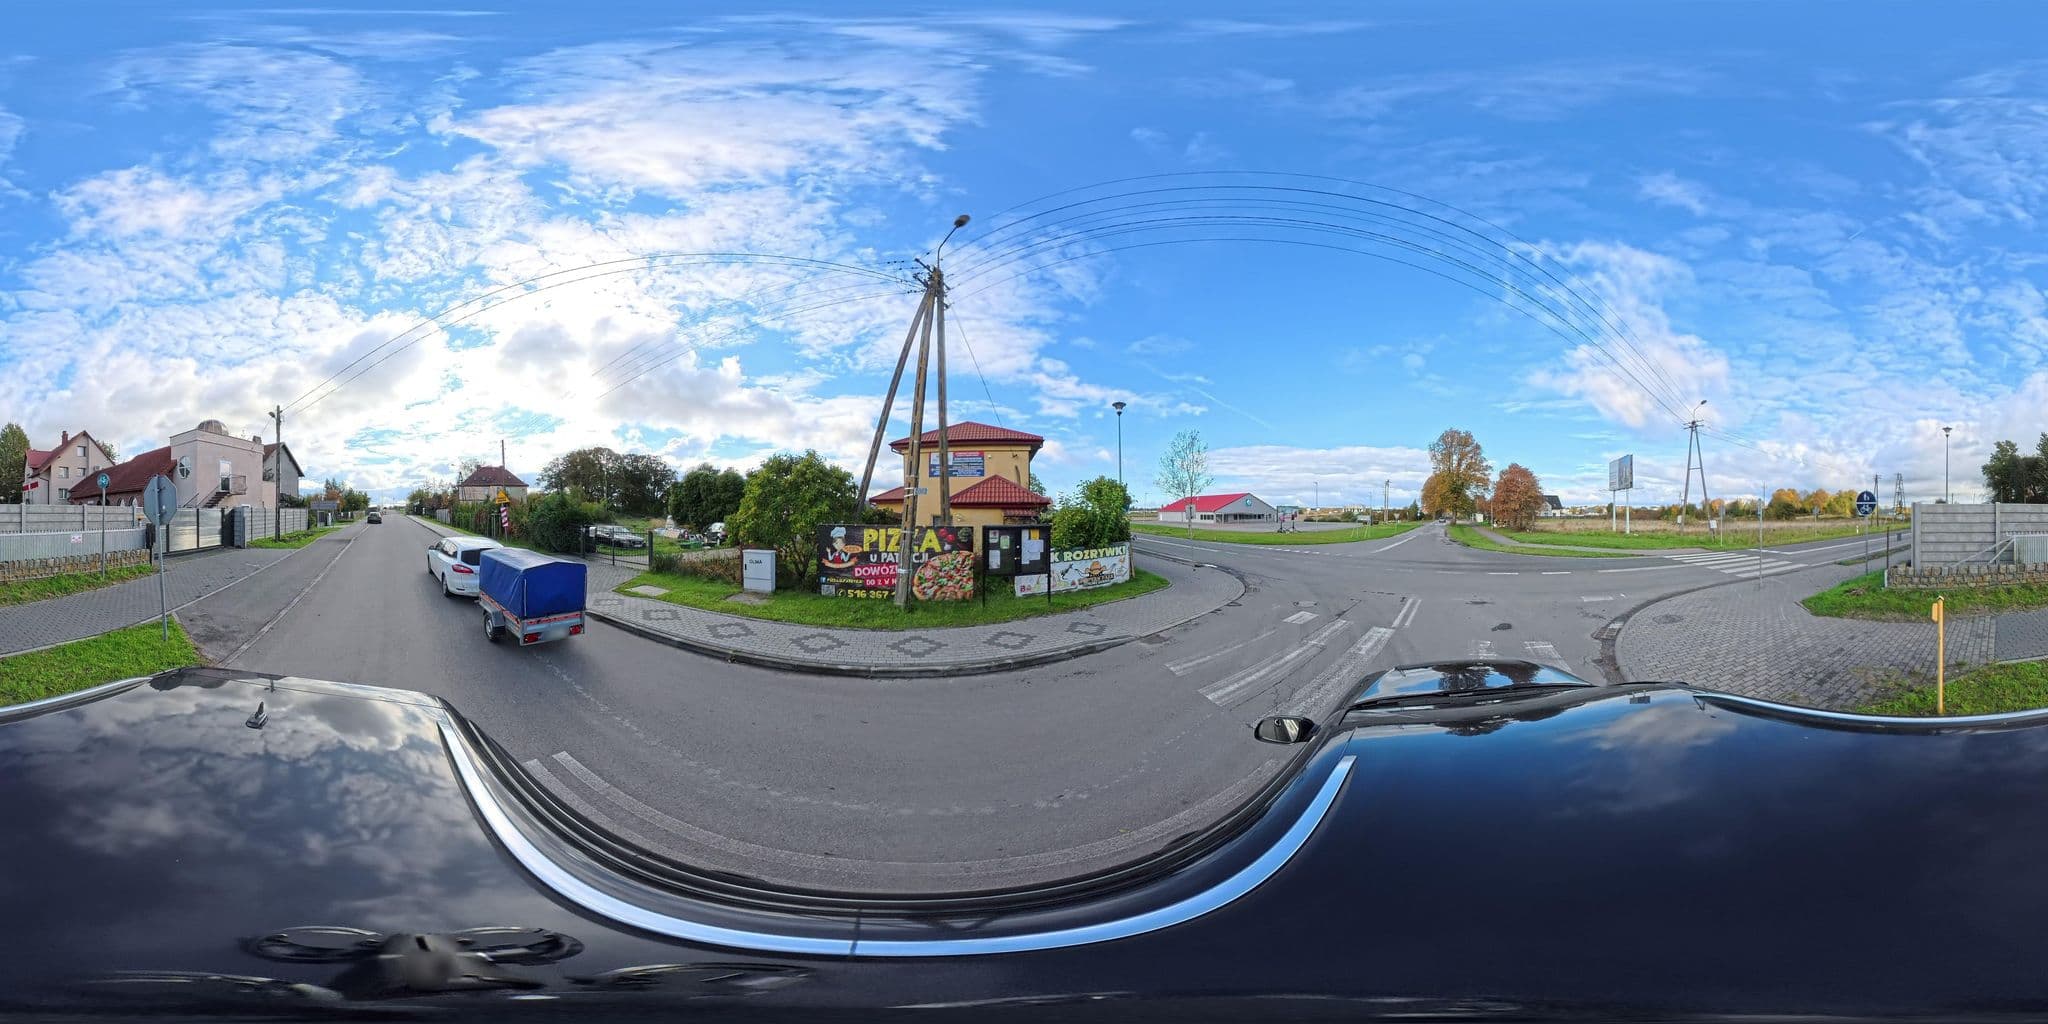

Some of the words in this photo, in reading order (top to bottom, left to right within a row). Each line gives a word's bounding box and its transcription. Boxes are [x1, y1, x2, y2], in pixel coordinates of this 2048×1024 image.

[870, 553, 877, 563] U
[881, 552, 929, 564] PATCJI
[1064, 546, 1126, 562] ROZRYWKI
[847, 589, 866, 598] 516
[869, 590, 889, 599] 367
